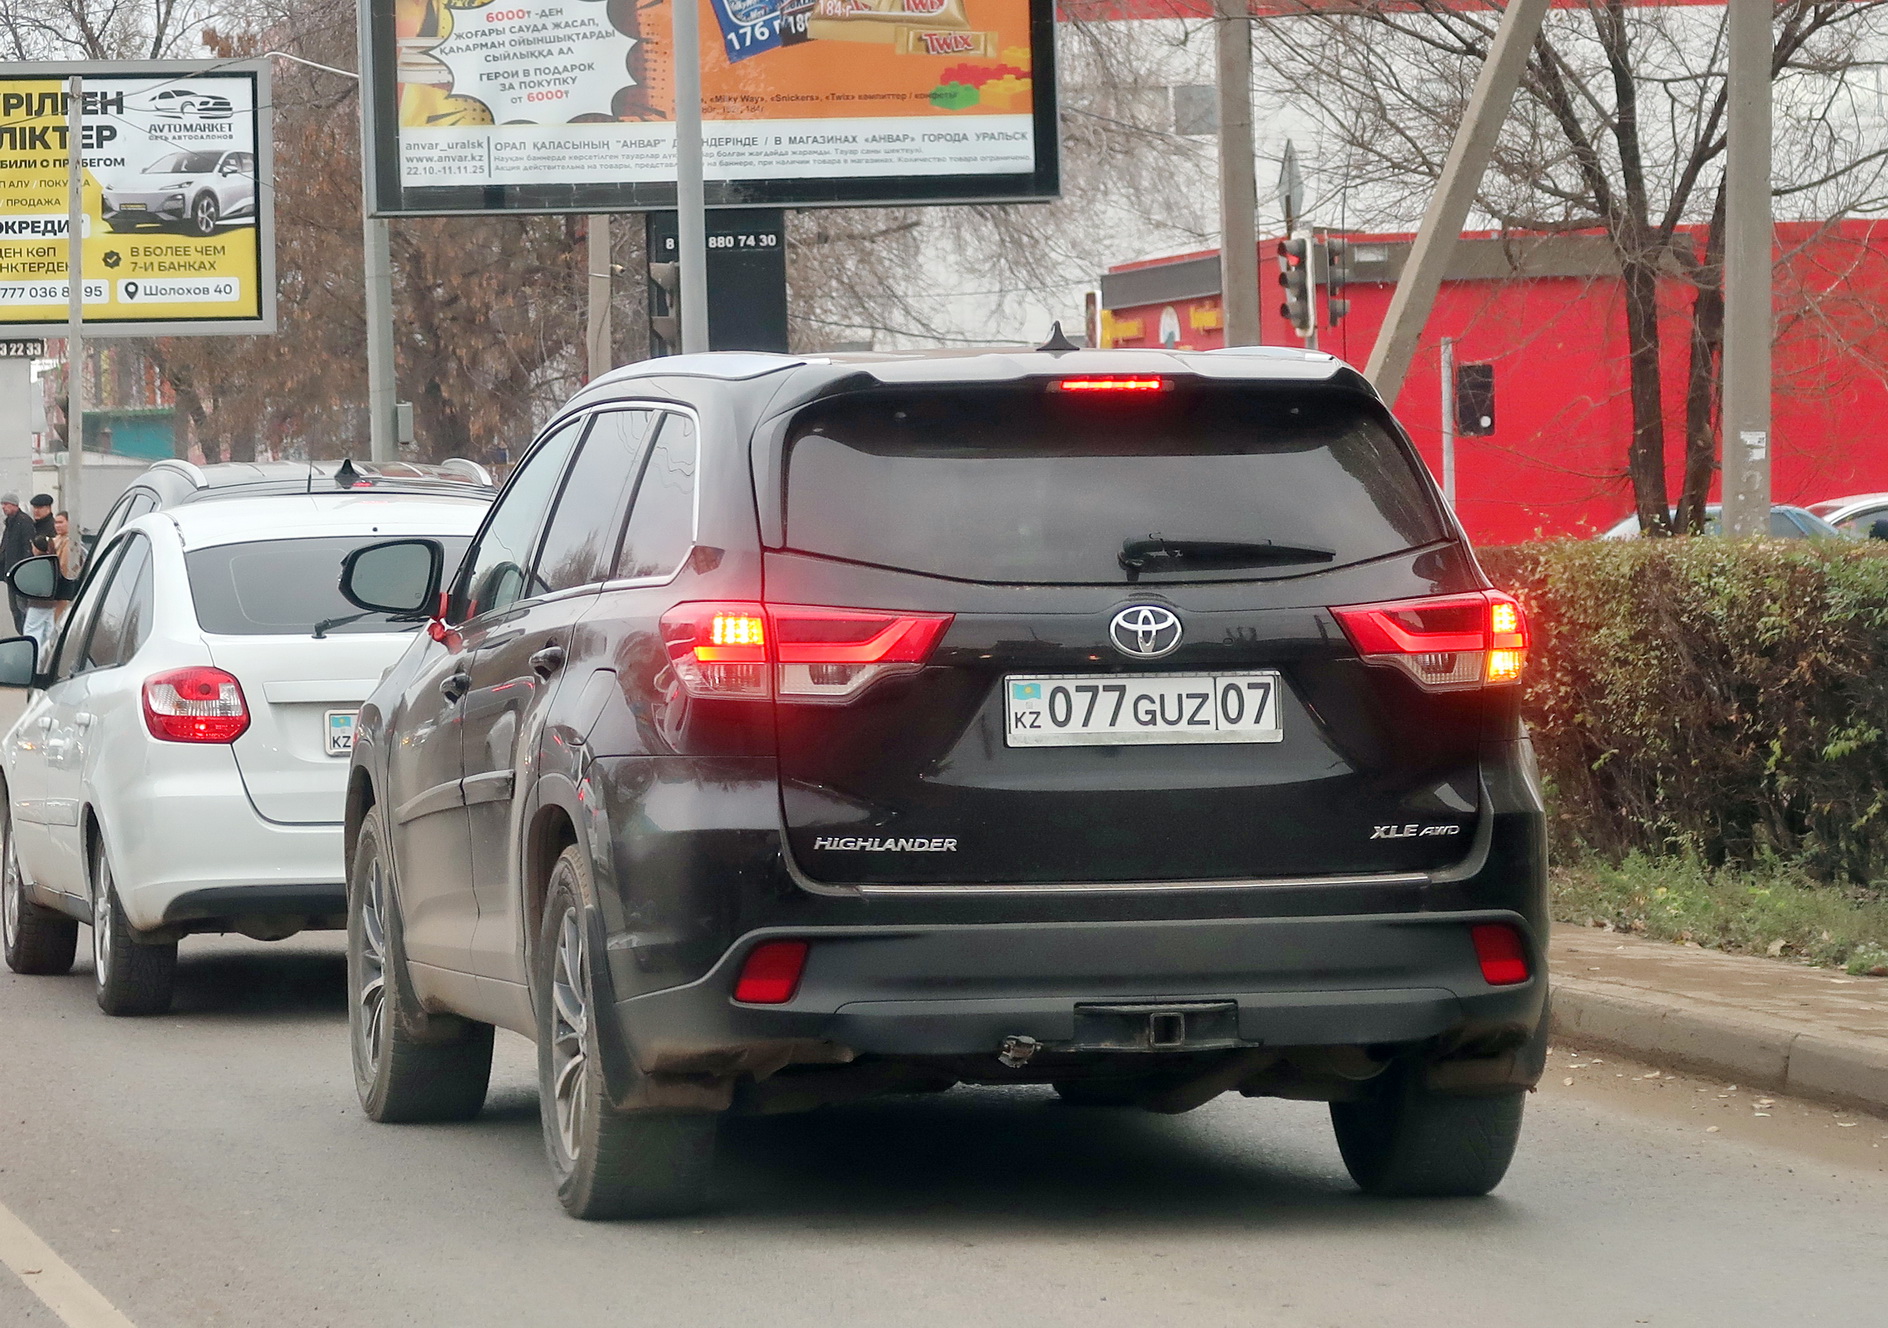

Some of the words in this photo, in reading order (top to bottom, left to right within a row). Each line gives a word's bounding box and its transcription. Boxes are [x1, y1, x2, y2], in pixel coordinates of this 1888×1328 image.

[454, 27, 506, 40] ЖОҒАРЫ
[509, 23, 548, 34] САУДА
[552, 18, 599, 30] ЖАСАП,
[727, 22, 770, 50] 176
[509, 30, 615, 47] ОЙЫНШЫҚТАРДЫ
[484, 49, 554, 62] СЫЙЛЫҚҚА
[558, 47, 574, 55] АЛ
[479, 70, 519, 81] ГЕРОИ
[523, 69, 531, 77] В
[534, 62, 595, 76] ПОДАРОК
[499, 83, 515, 91] ЗА
[519, 76, 577, 90] ПОКУПКУ
[0, 91, 124, 117] РІЛГЕН
[148, 123, 233, 133] AVTOMARKET
[405, 140, 484, 151] anvar_uralsk
[494, 142, 526, 151] ОРАЛ
[533, 140, 610, 151] ҚАЛАСЫНЫҢ
[774, 137, 782, 145] В
[789, 135, 858, 145] МАГАЗИНАХ
[922, 133, 969, 143] ГОРОДА
[975, 132, 1028, 141] УРАЛЬСК
[40, 159, 50, 168] С
[53, 157, 125, 168] ПРБЕГОМ
[405, 154, 484, 163] www.anvar.kz
[406, 165, 485, 175] 22.10.-11.11.25
[9, 180, 30, 188] АЛУ
[39, 179, 91, 188] ПОКУА
[7, 198, 61, 208] ПРОДАЖА
[0, 220, 84, 236] КРЕДИ
[665, 238, 675, 249] 8
[708, 236, 734, 248] 880
[738, 235, 756, 247] 74
[759, 234, 777, 246] 30
[27, 247, 57, 257] КӨП
[130, 247, 139, 257] В
[143, 246, 191, 256] БОЛЕЕ
[194, 245, 226, 256] ЧЕМ
[130, 261, 154, 272] 7-И
[158, 260, 217, 271] БАНКАХ
[29, 287, 57, 298] 036
[84, 286, 102, 297] 95
[143, 284, 210, 296] Шолохов
[214, 284, 233, 295] 40
[9, 343, 24, 356] 22
[26, 342, 41, 355] 33
[1014, 712, 1041, 729] KZ
[1221, 682, 1271, 725] 07
[333, 735, 351, 748] KZ
[1370, 824, 1419, 839] XLE
[1419, 825, 1460, 836] AWD
[814, 837, 958, 852] HIGHLANDER
